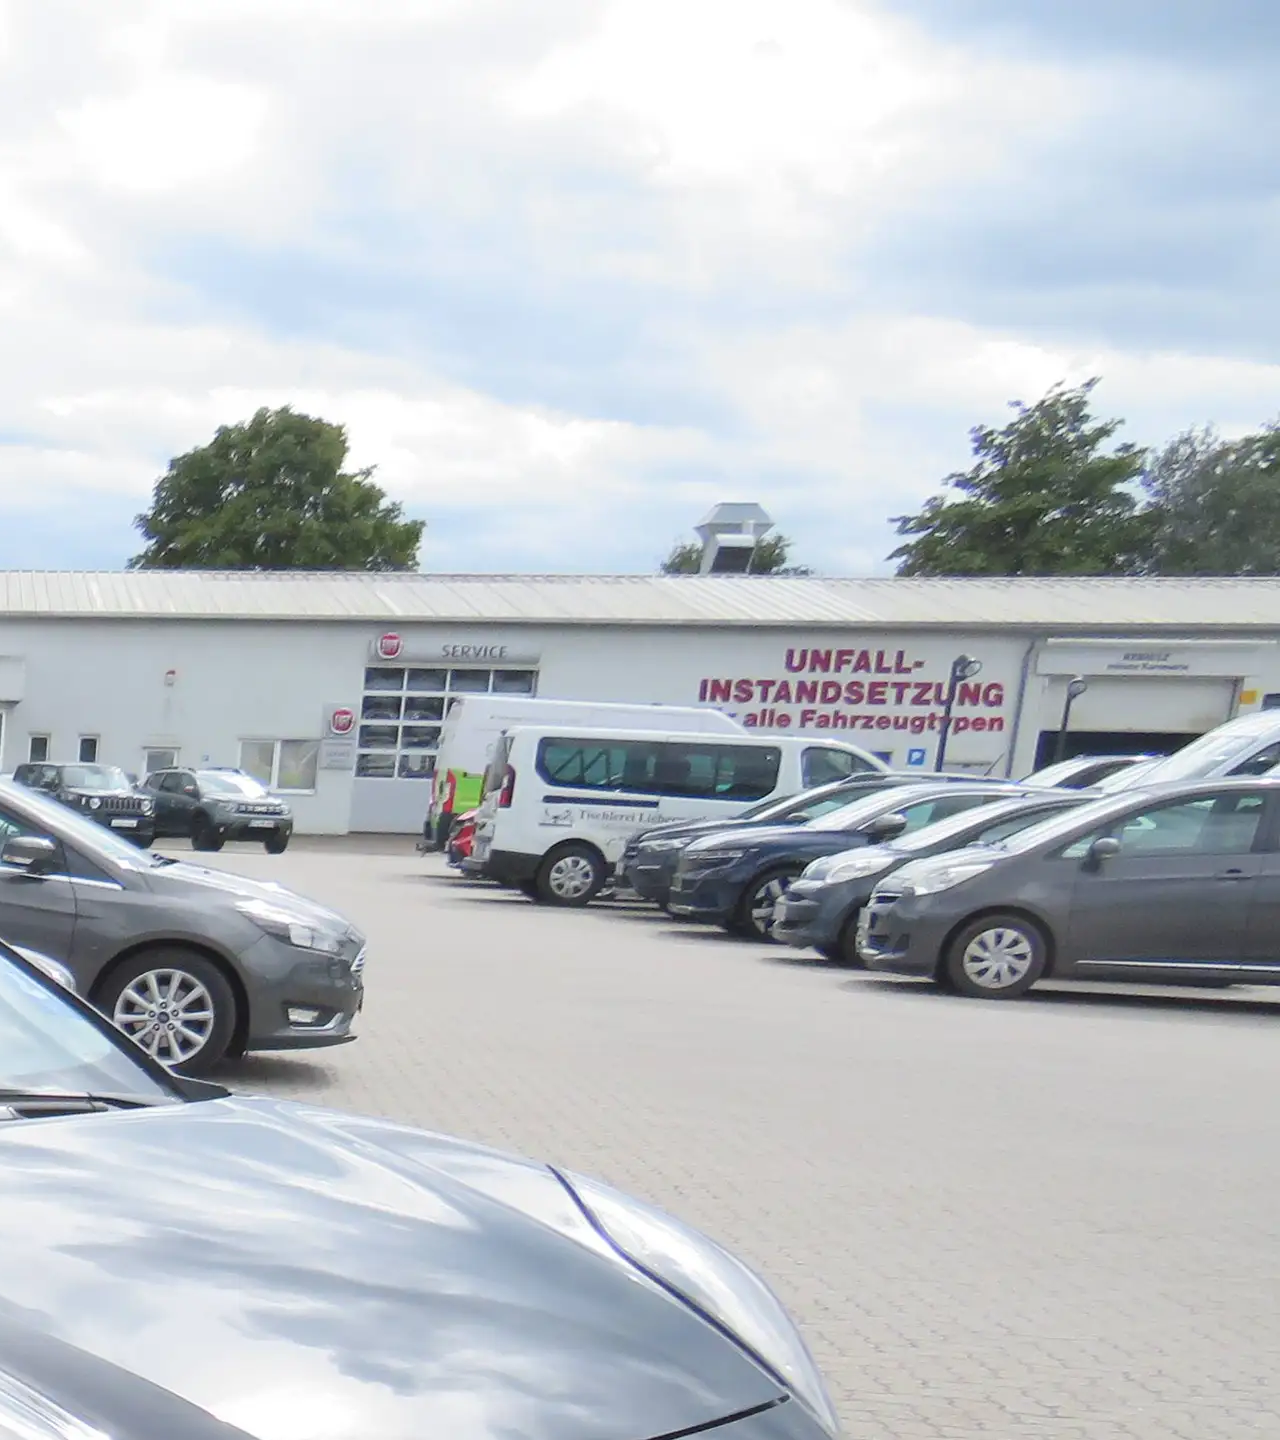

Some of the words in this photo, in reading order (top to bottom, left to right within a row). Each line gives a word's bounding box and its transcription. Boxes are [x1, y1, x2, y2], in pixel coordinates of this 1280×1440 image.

[441, 645, 508, 659] SERVICE
[785, 648, 925, 674] UNFALL-
[698, 678, 1004, 708] INSTANDSETZUNG
[743, 709, 790, 729] alle
